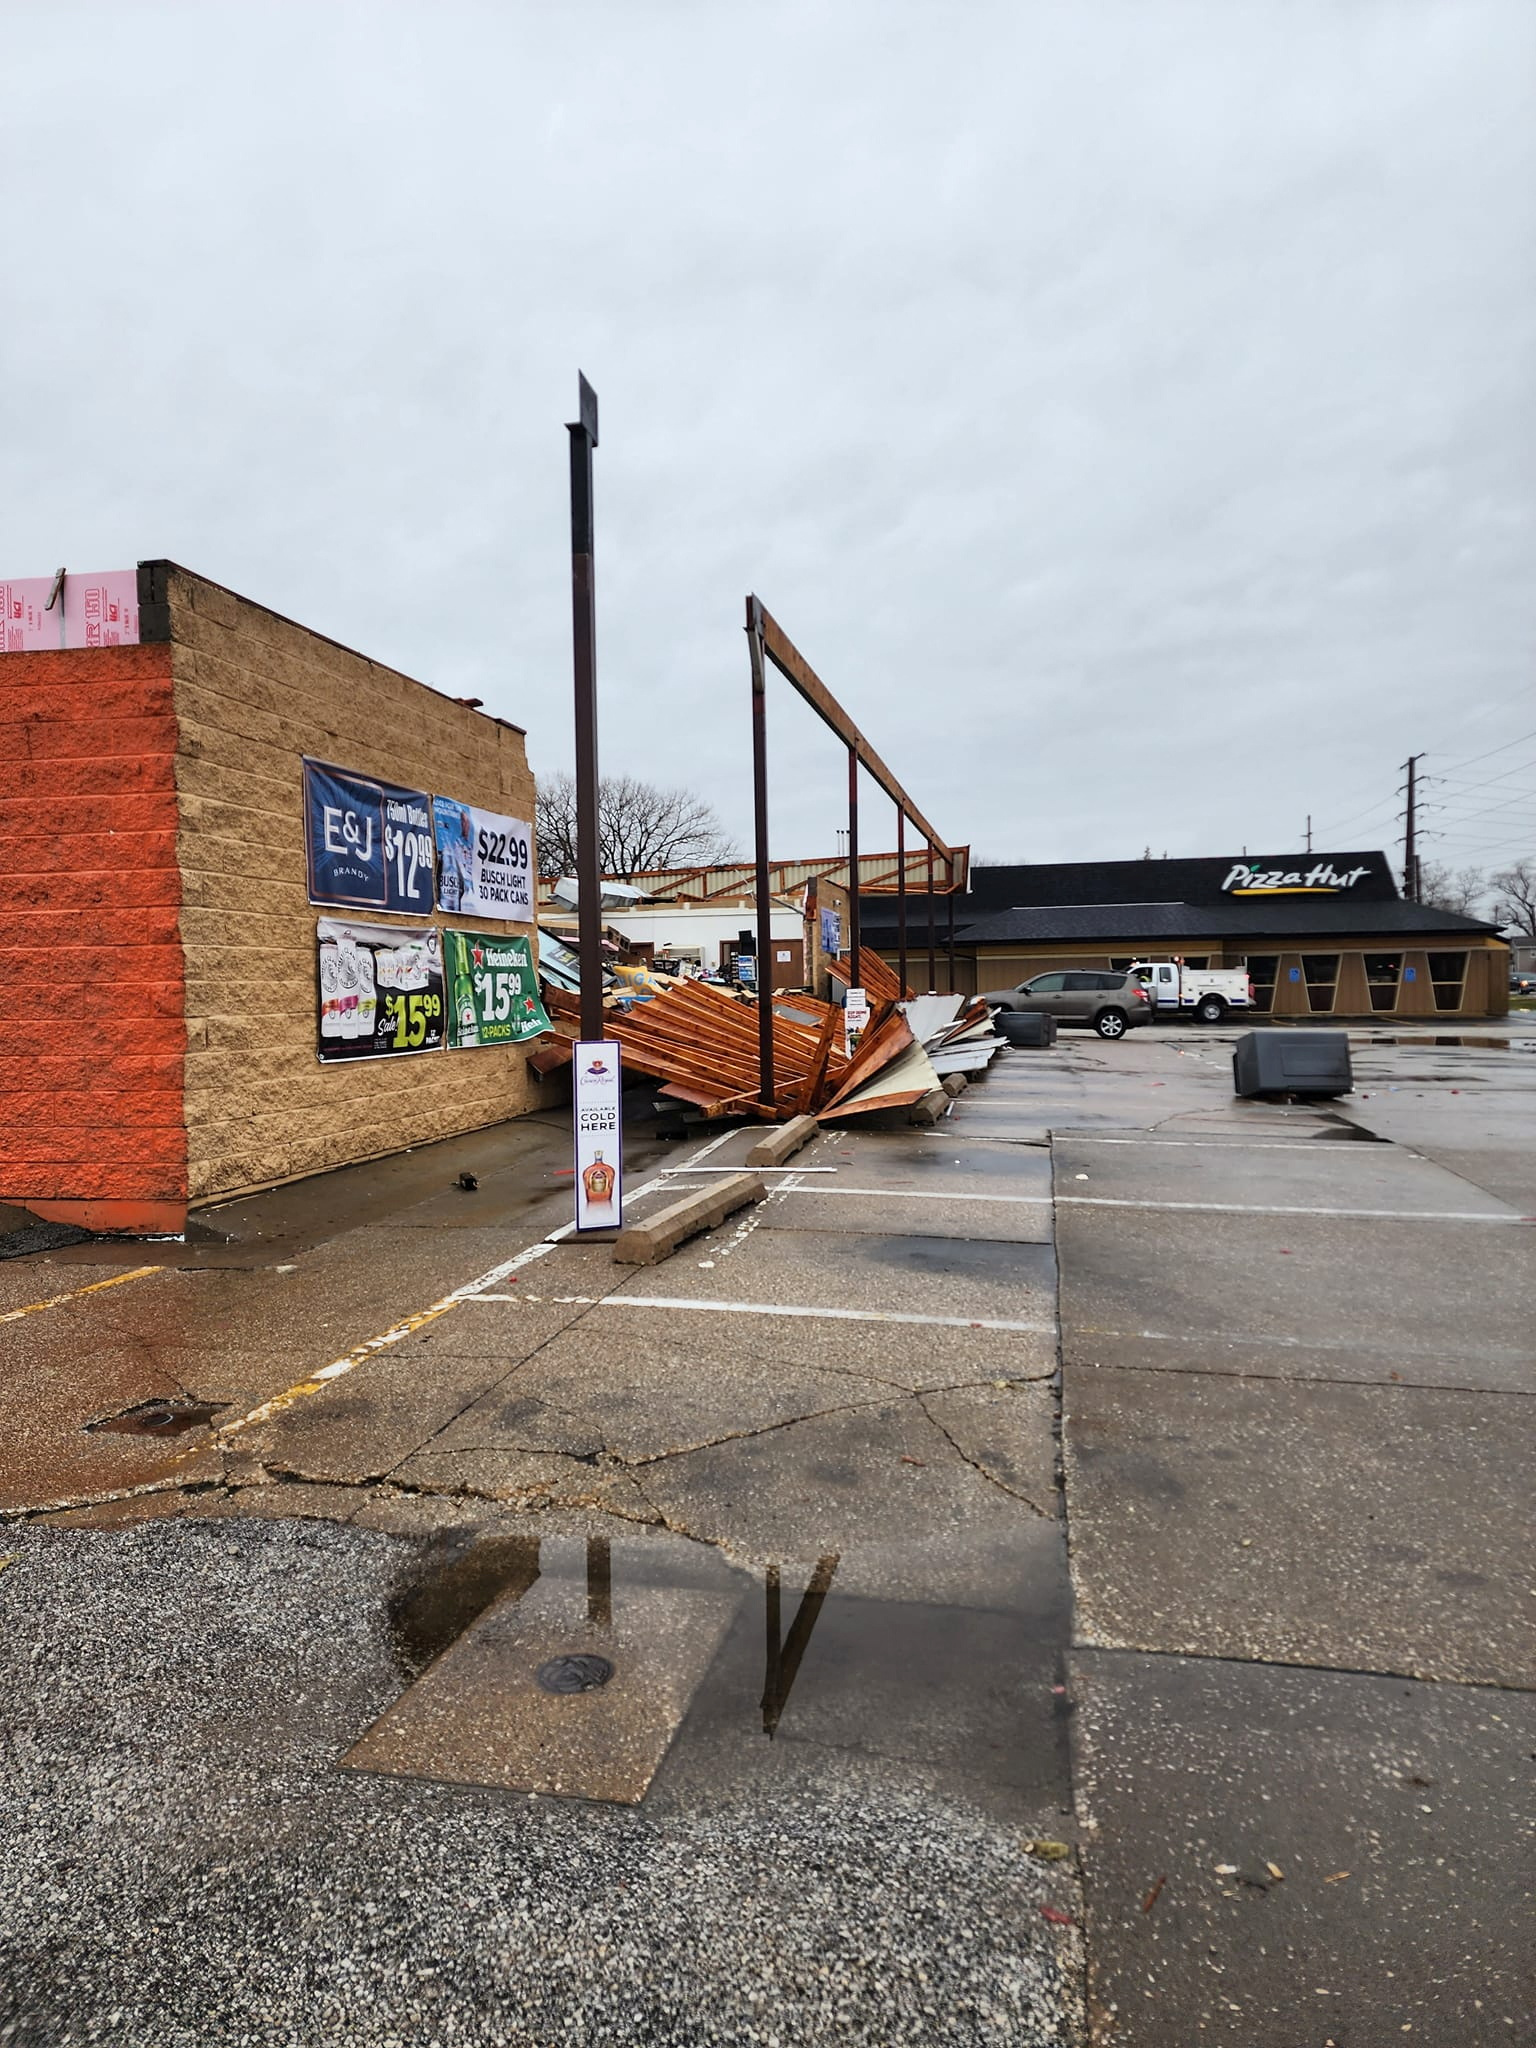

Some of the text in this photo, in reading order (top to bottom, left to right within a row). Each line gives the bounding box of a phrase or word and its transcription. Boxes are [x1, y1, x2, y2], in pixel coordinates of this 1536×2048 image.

[85, 588, 100, 618] 150
[324, 805, 373, 862] E&J
[477, 826, 529, 870] $22.99
[333, 866, 369, 882] BRANDY
[480, 868, 527, 890] BUSCH LIGHT
[1221, 863, 1372, 891] Pizza Hut
[478, 886, 529, 906] 30 PACK CANS
[485, 947, 529, 967] Heineken
[481, 1024, 511, 1039] 12-PACKS
[581, 1112, 616, 1121] COLD
[581, 1122, 616, 1131] HERE
